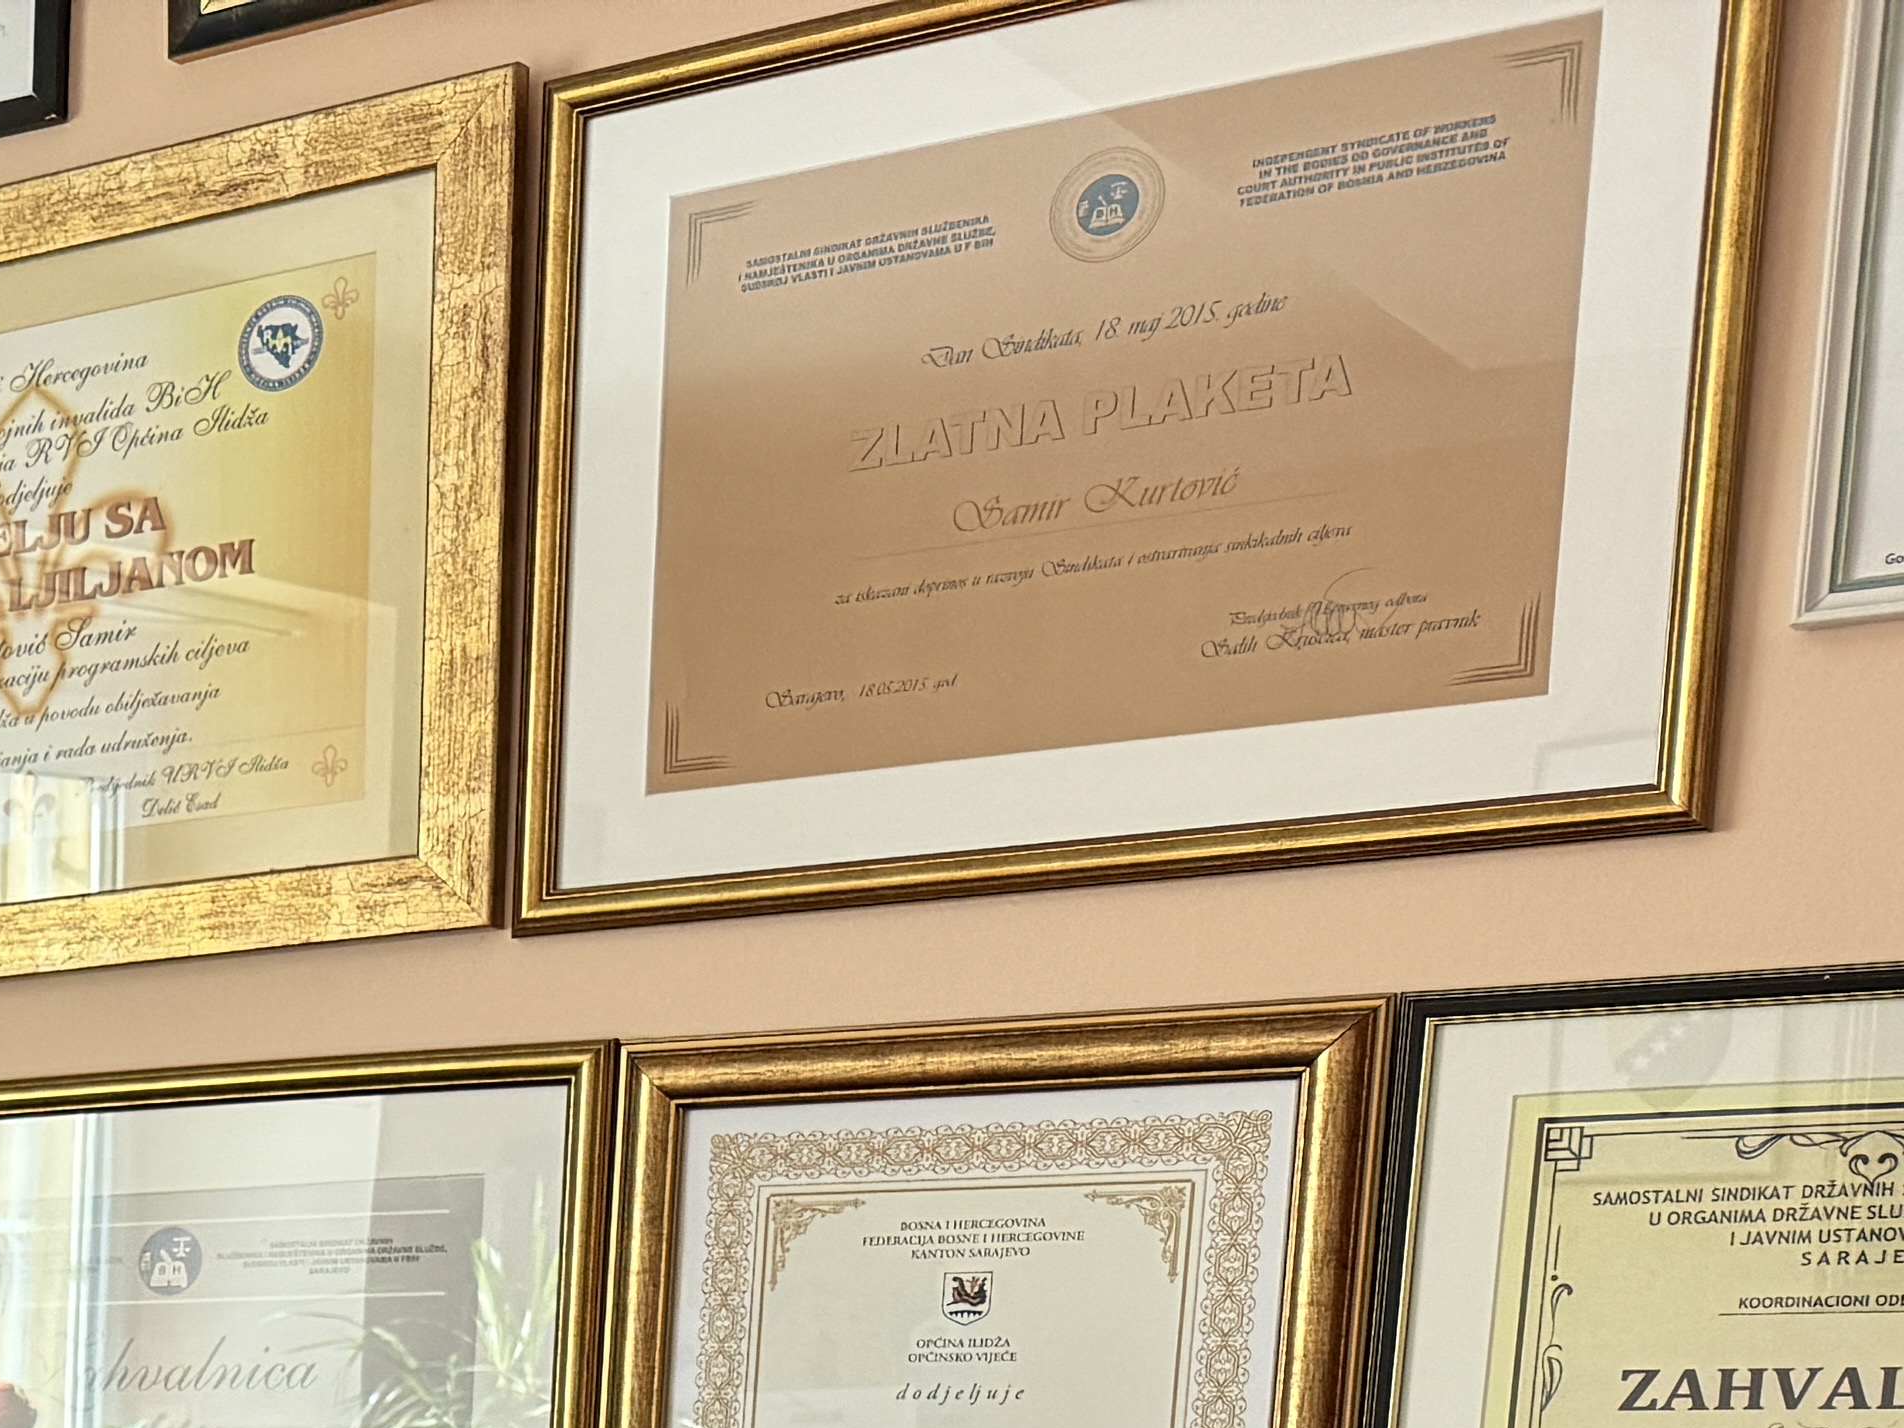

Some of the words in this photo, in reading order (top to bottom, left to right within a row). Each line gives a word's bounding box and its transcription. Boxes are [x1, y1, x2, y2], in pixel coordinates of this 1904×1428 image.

[921, 345, 973, 368] Dan
[980, 327, 1085, 360] Sindikata,
[1164, 299, 1221, 331] 2015.
[9, 352, 149, 392] Hercegovina
[50, 393, 135, 430] invalida
[145, 370, 232, 413] BiH
[848, 398, 1065, 473] ZLATNA
[1083, 354, 1353, 436] PLAKETA
[193, 402, 270, 437] Ilidža
[104, 496, 167, 539] SA
[952, 492, 1073, 533] Samir
[1084, 465, 1243, 515] Kurtović
[8, 537, 256, 612] LJILJANOM
[54, 617, 138, 651] Samir
[50, 638, 180, 692] programskih
[185, 638, 251, 671] ciljeva
[1592, 1187, 1704, 1206] SAMOSTALNI
[1711, 1185, 1797, 1202] SINDIKAT
[1801, 1180, 1895, 1200] DRŽAVNIH
[1667, 1207, 1767, 1226] ORGANIMA
[1772, 1203, 1863, 1222] DRŽAVNE
[862, 1235, 934, 1247] FEDERACIJA
[911, 1249, 965, 1260] KANTON
[968, 1246, 1031, 1260] SARAJEVO
[1739, 1229, 1813, 1246] JAVNIM
[1738, 1295, 1871, 1310] KOORDINACIONI
[967, 1335, 1011, 1348] ILIDŽA
[1617, 1366, 1904, 1412] ZAHVAL
